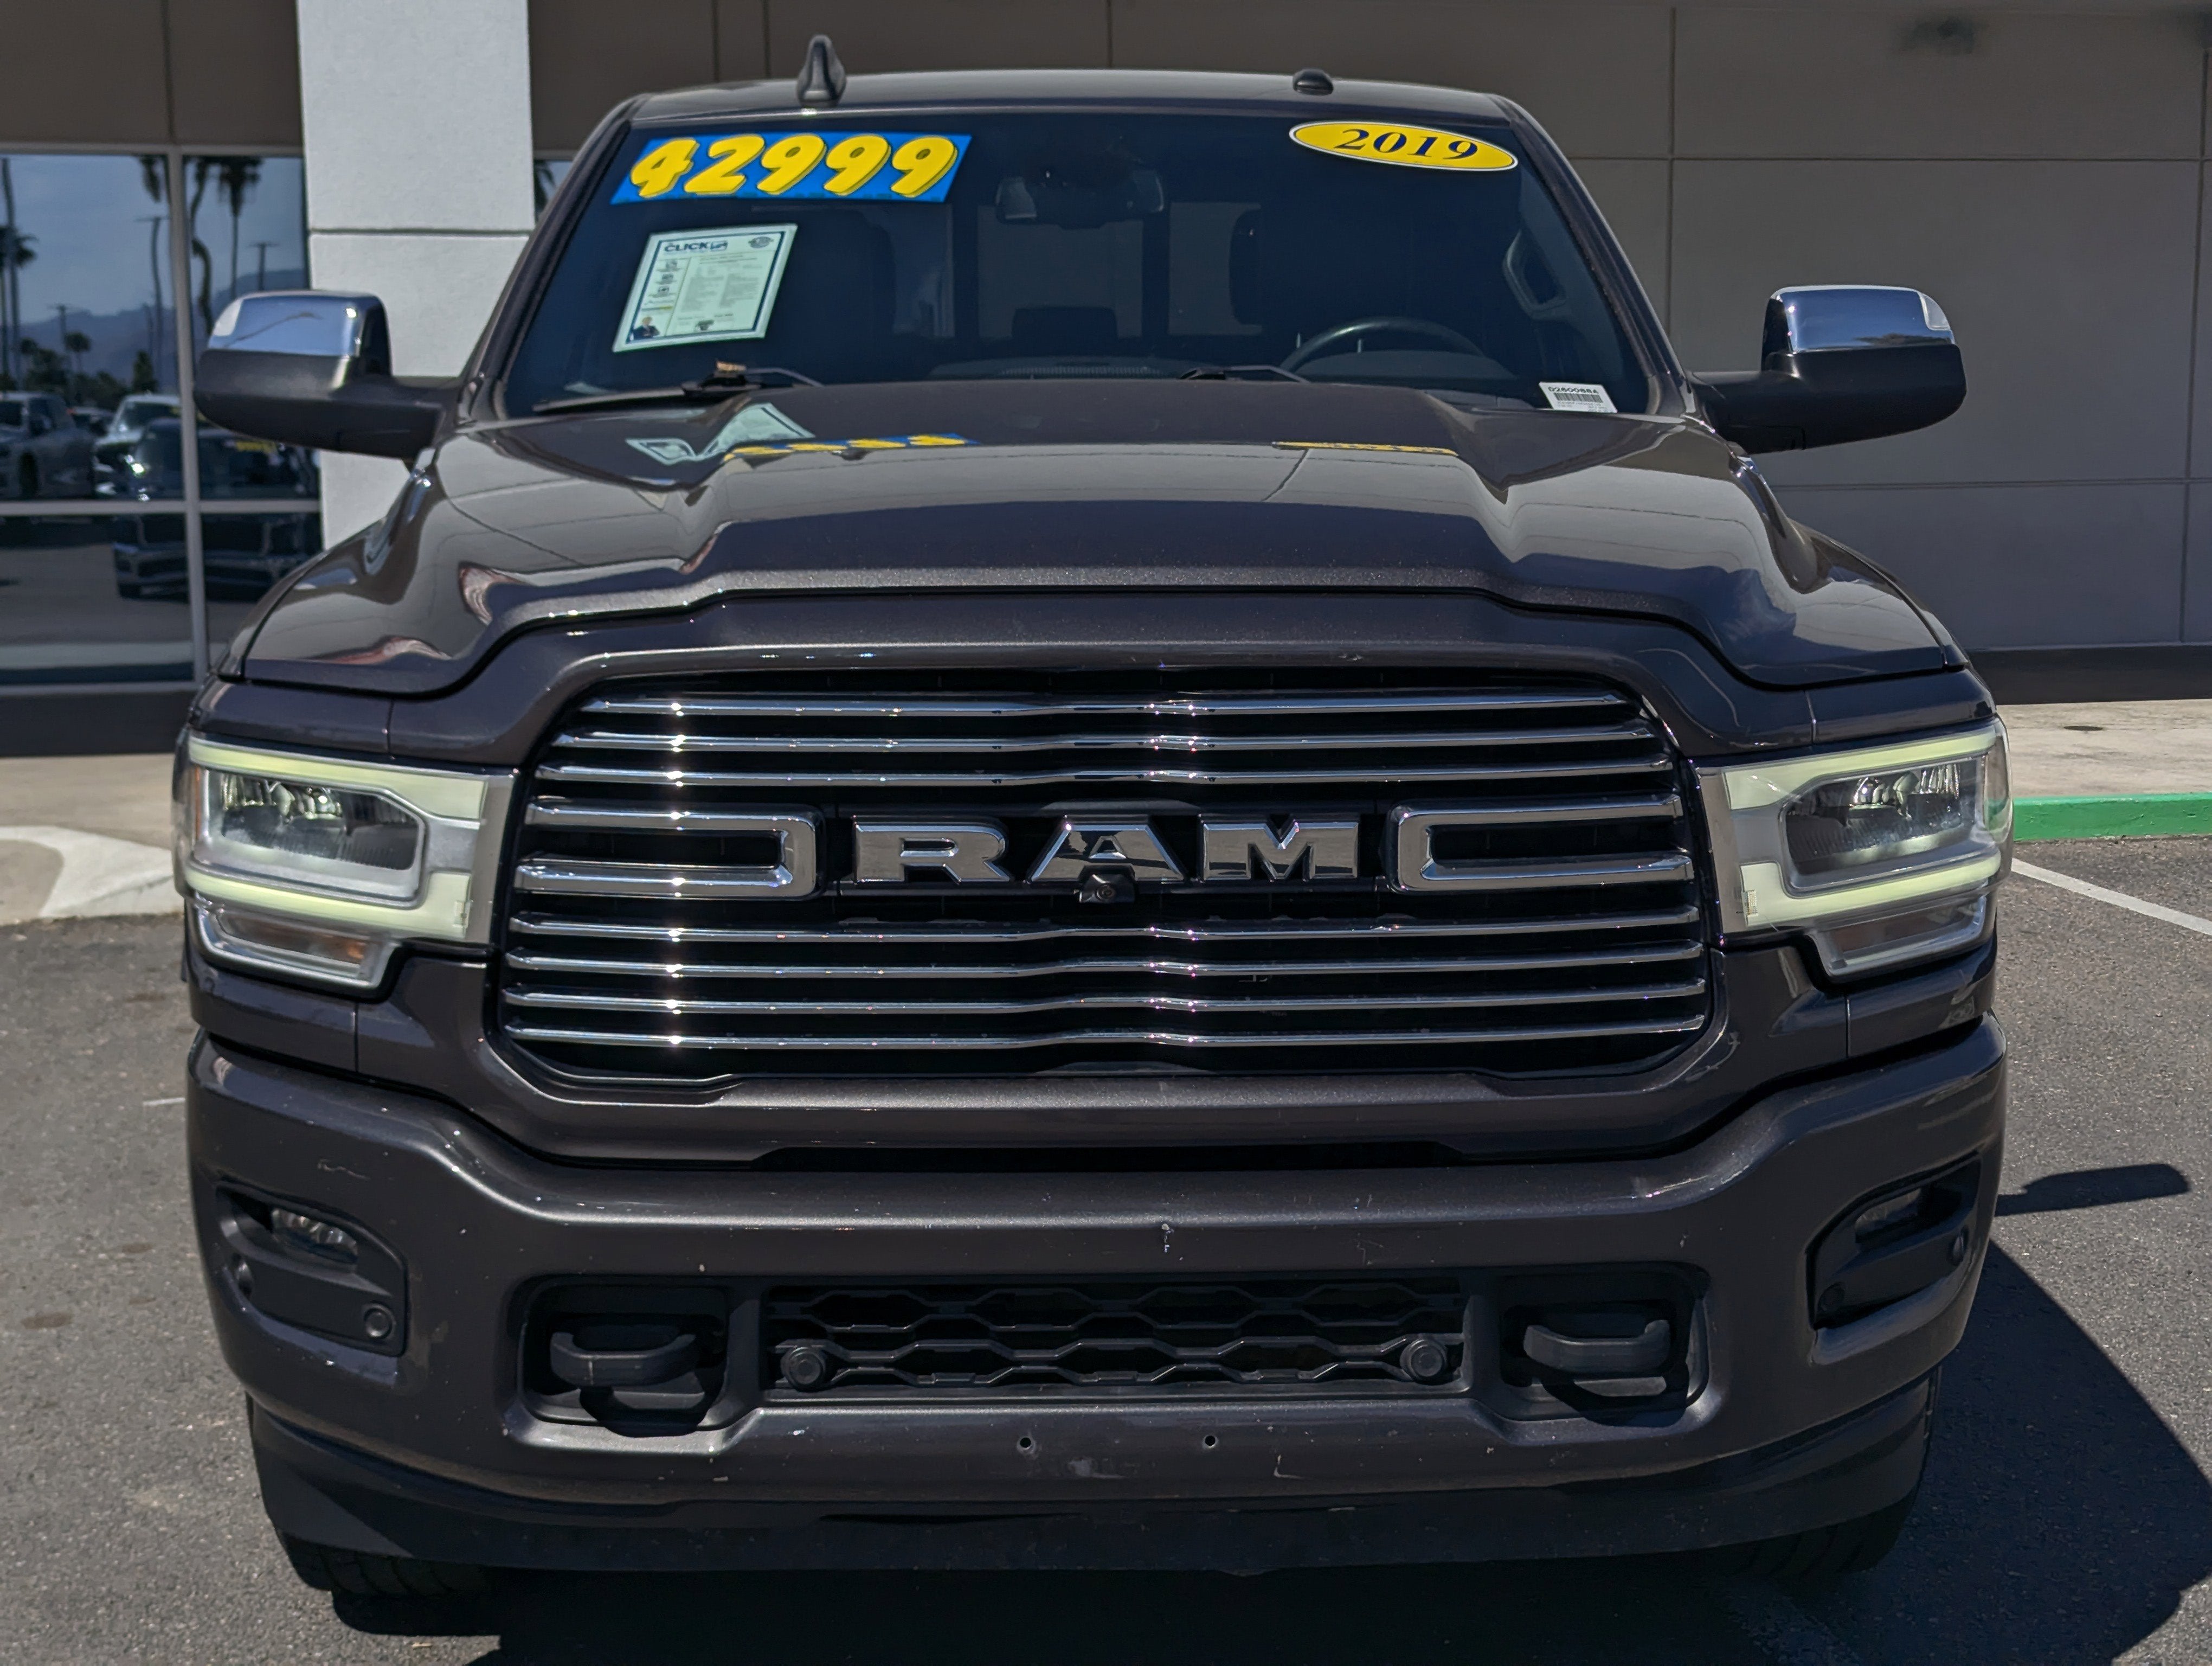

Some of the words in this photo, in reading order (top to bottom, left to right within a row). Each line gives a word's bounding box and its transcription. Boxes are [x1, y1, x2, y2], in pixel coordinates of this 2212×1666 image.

[631, 133, 959, 198] 42999
[1334, 129, 1478, 160] 2019
[665, 242, 708, 251] CLICK
[853, 814, 1359, 883] RAM
